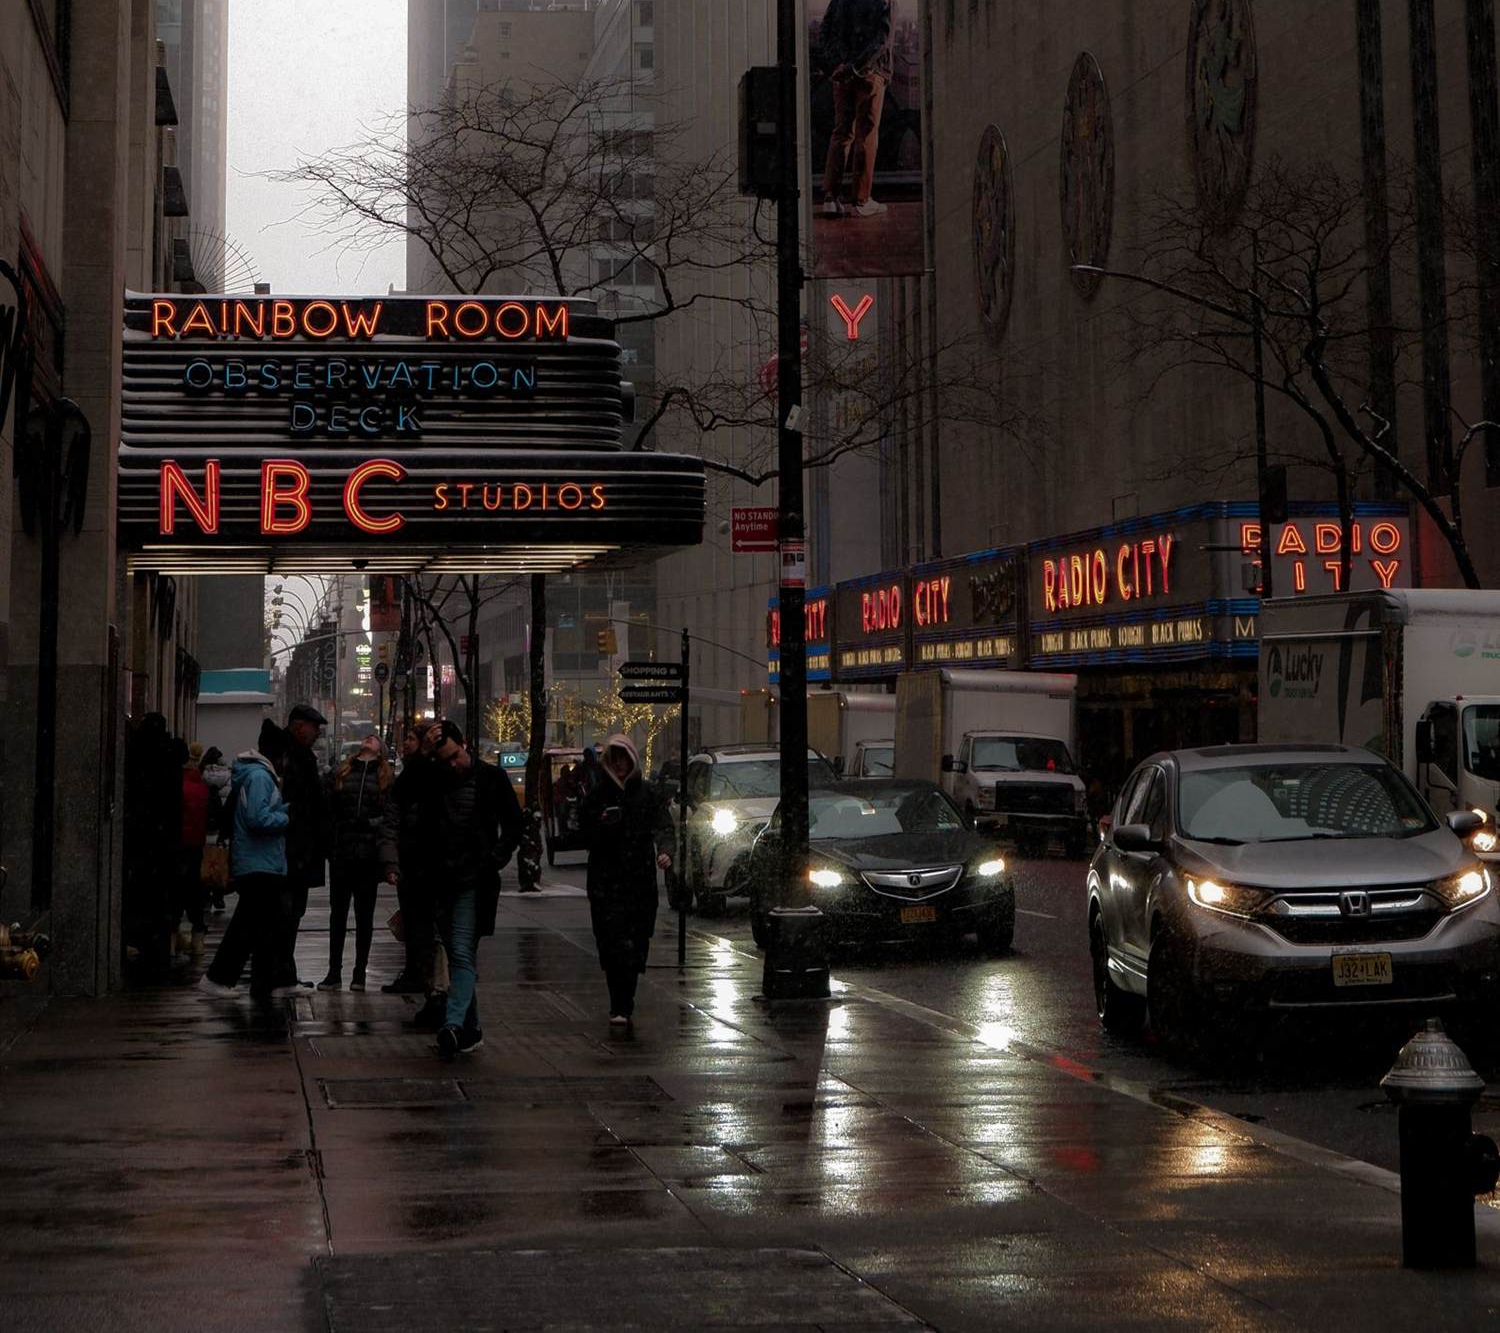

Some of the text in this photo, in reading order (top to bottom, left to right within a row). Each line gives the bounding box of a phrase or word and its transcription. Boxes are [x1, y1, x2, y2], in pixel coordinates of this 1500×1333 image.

[152, 299, 569, 341] RAINBOW ROOM
[830, 293, 874, 340] Y
[183, 357, 537, 392] OBSERVATION
[291, 403, 422, 434] DECK
[159, 459, 606, 535] NBC STUDIOS
[734, 511, 745, 521] NO
[735, 522, 768, 533] Anytime
[1240, 522, 1402, 555] RADIO
[1041, 533, 1174, 613] RADIO CITY
[1250, 559, 1401, 594] ITY
[862, 575, 951, 634] RADIO CITY
[1151, 622, 1174, 644] BLACK
[1178, 619, 1202, 642] PUMAS
[621, 666, 667, 675] SHOPPING
[1285, 645, 1324, 694] Lucky
